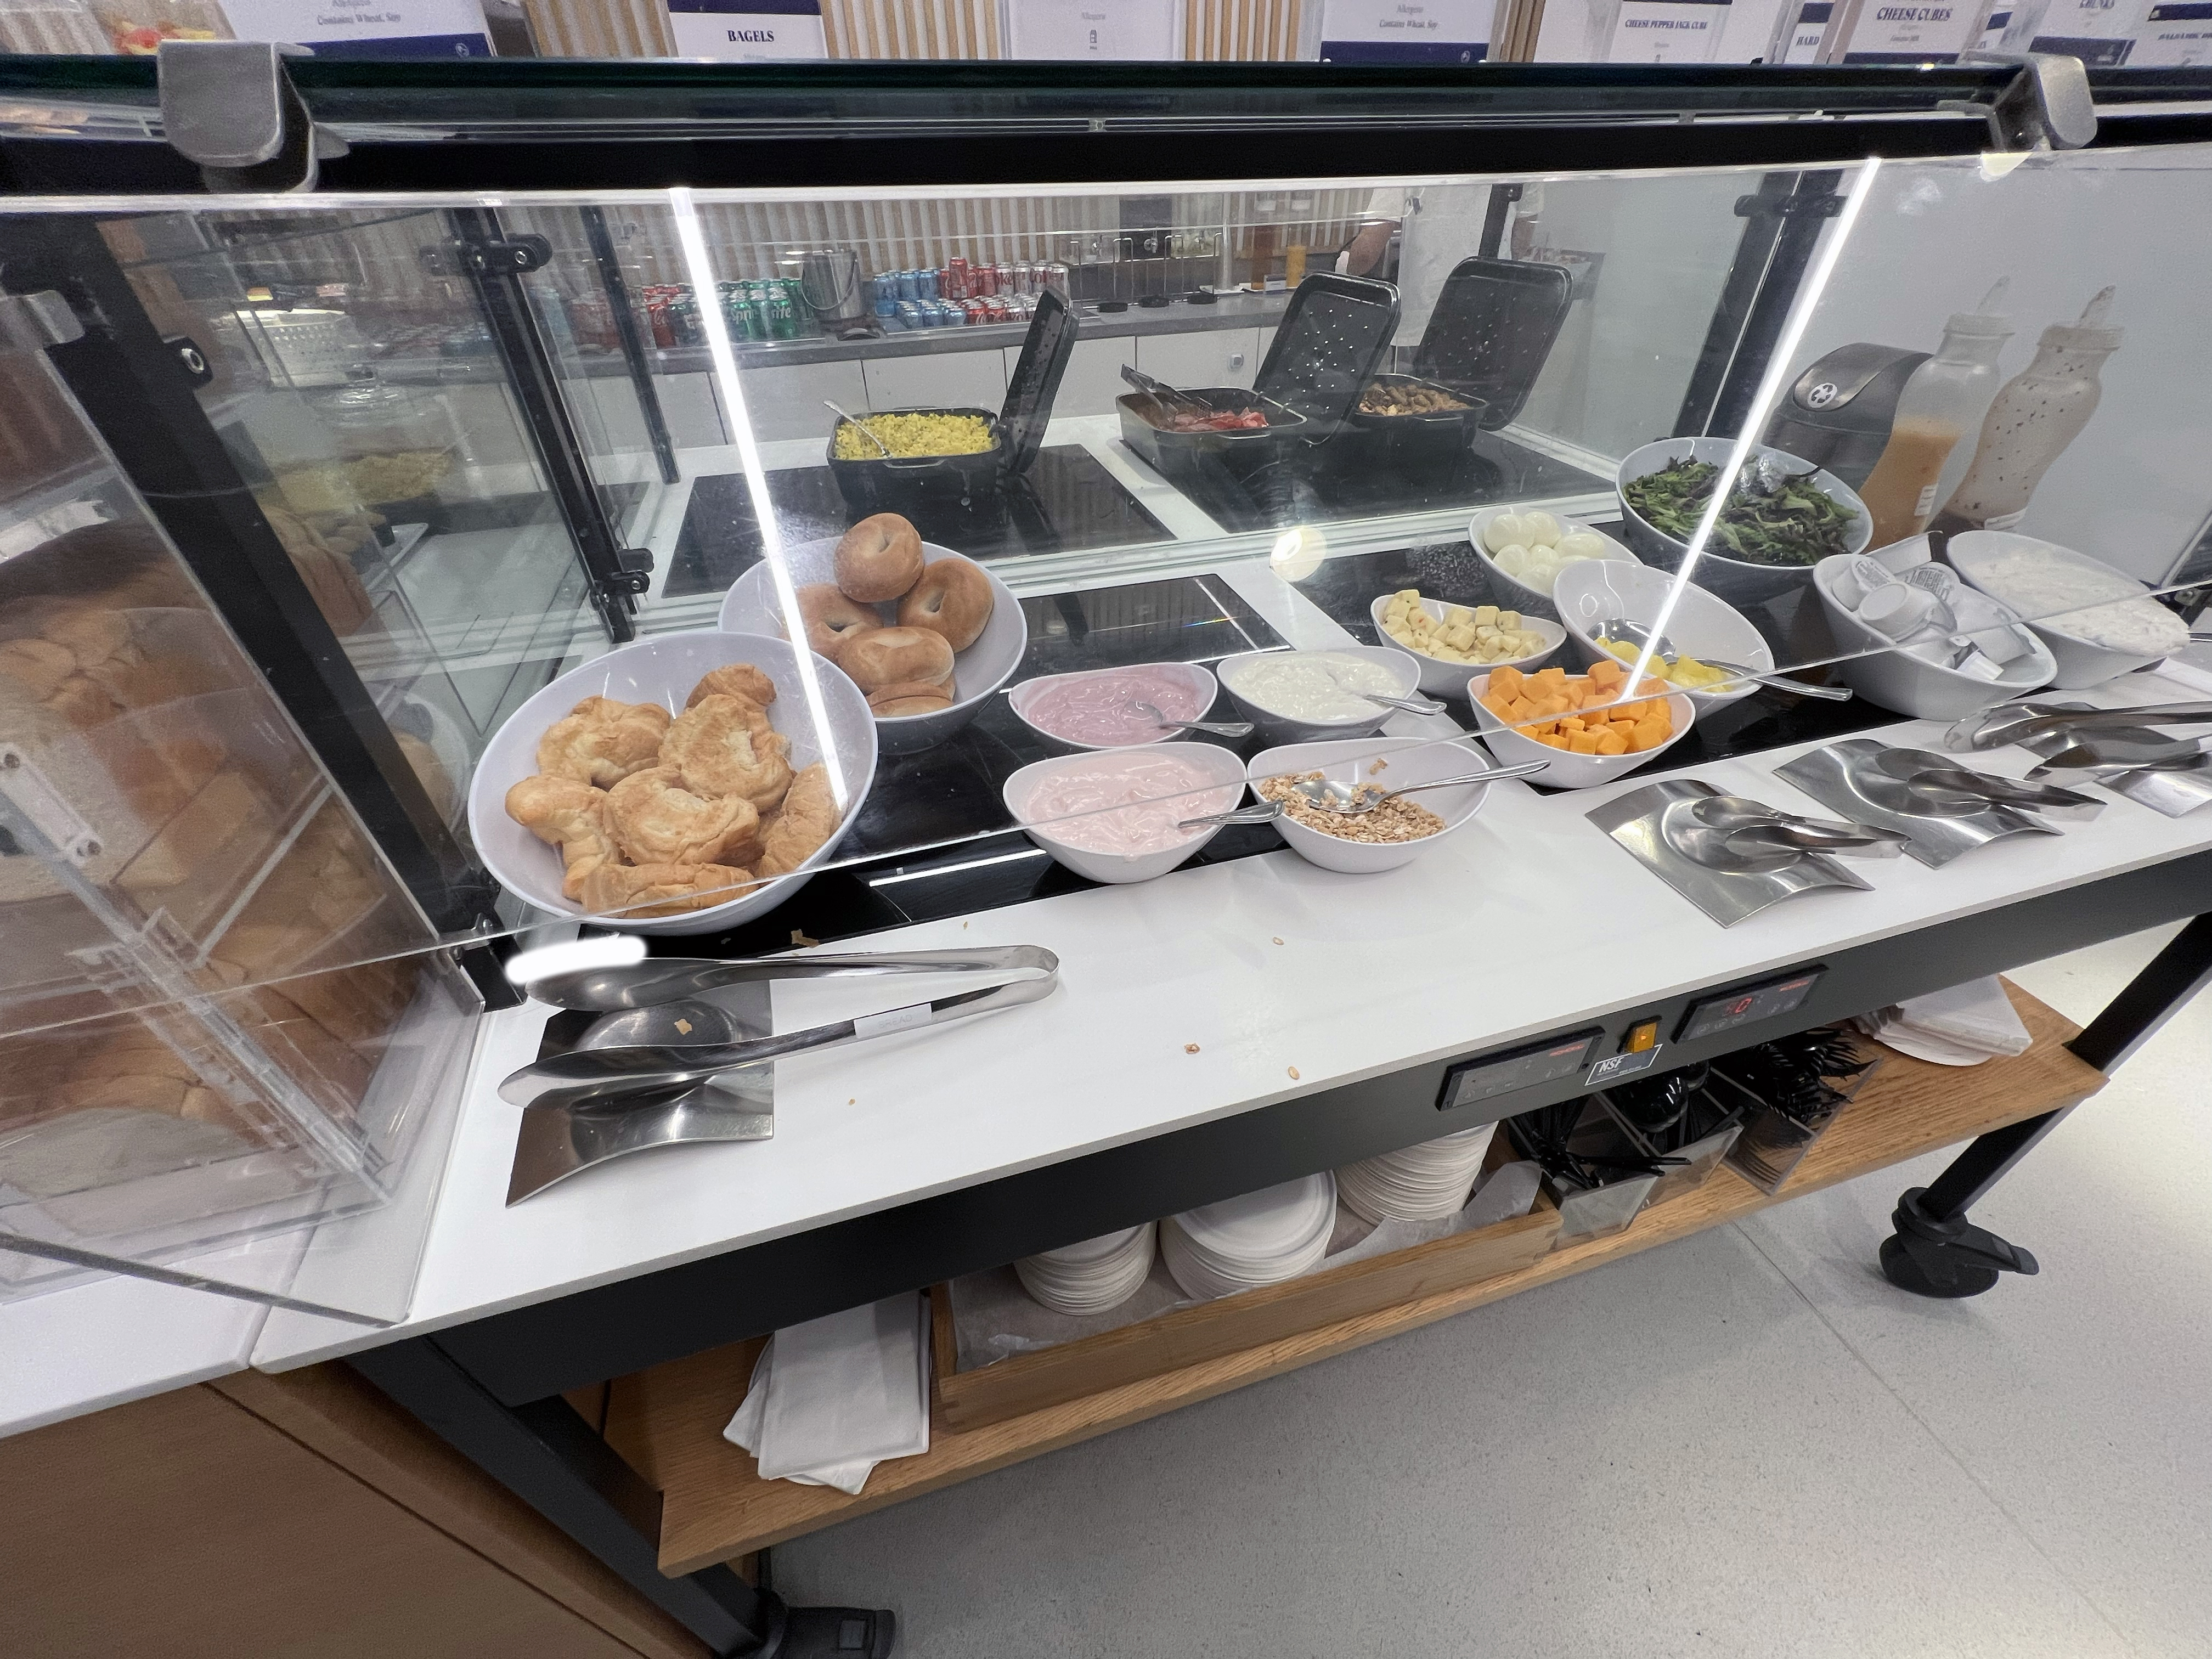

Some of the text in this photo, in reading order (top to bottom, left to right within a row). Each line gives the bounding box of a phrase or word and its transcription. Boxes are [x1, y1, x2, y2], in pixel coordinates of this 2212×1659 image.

[1876, 7, 1953, 21] CHEESE CUBES
[726, 30, 775, 42] BAGELS
[1598, 1056, 1625, 1073] NSF
